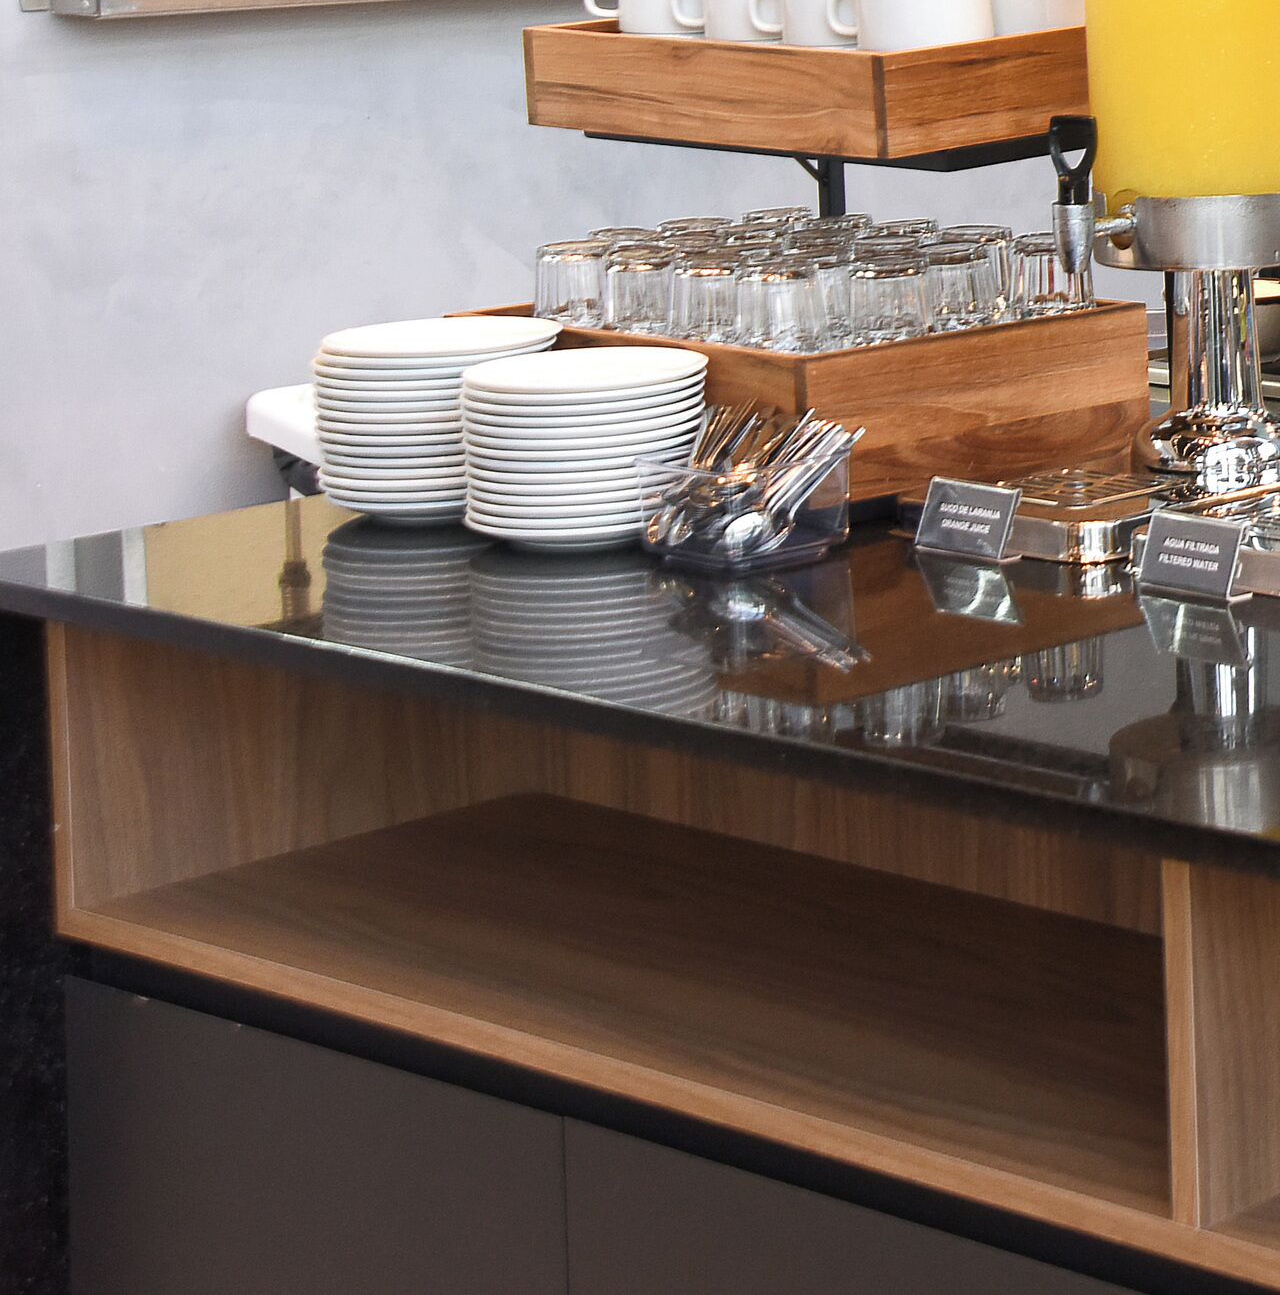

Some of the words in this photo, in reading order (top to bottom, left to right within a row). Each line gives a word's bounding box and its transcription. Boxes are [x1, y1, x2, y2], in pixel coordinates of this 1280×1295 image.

[958, 505, 969, 516] DE
[969, 506, 1000, 519] LARANJA
[941, 518, 970, 532] ORANGE
[1185, 540, 1220, 555] FILTRADA
[1158, 552, 1192, 568] FILTERED
[1192, 558, 1219, 572] WATER
